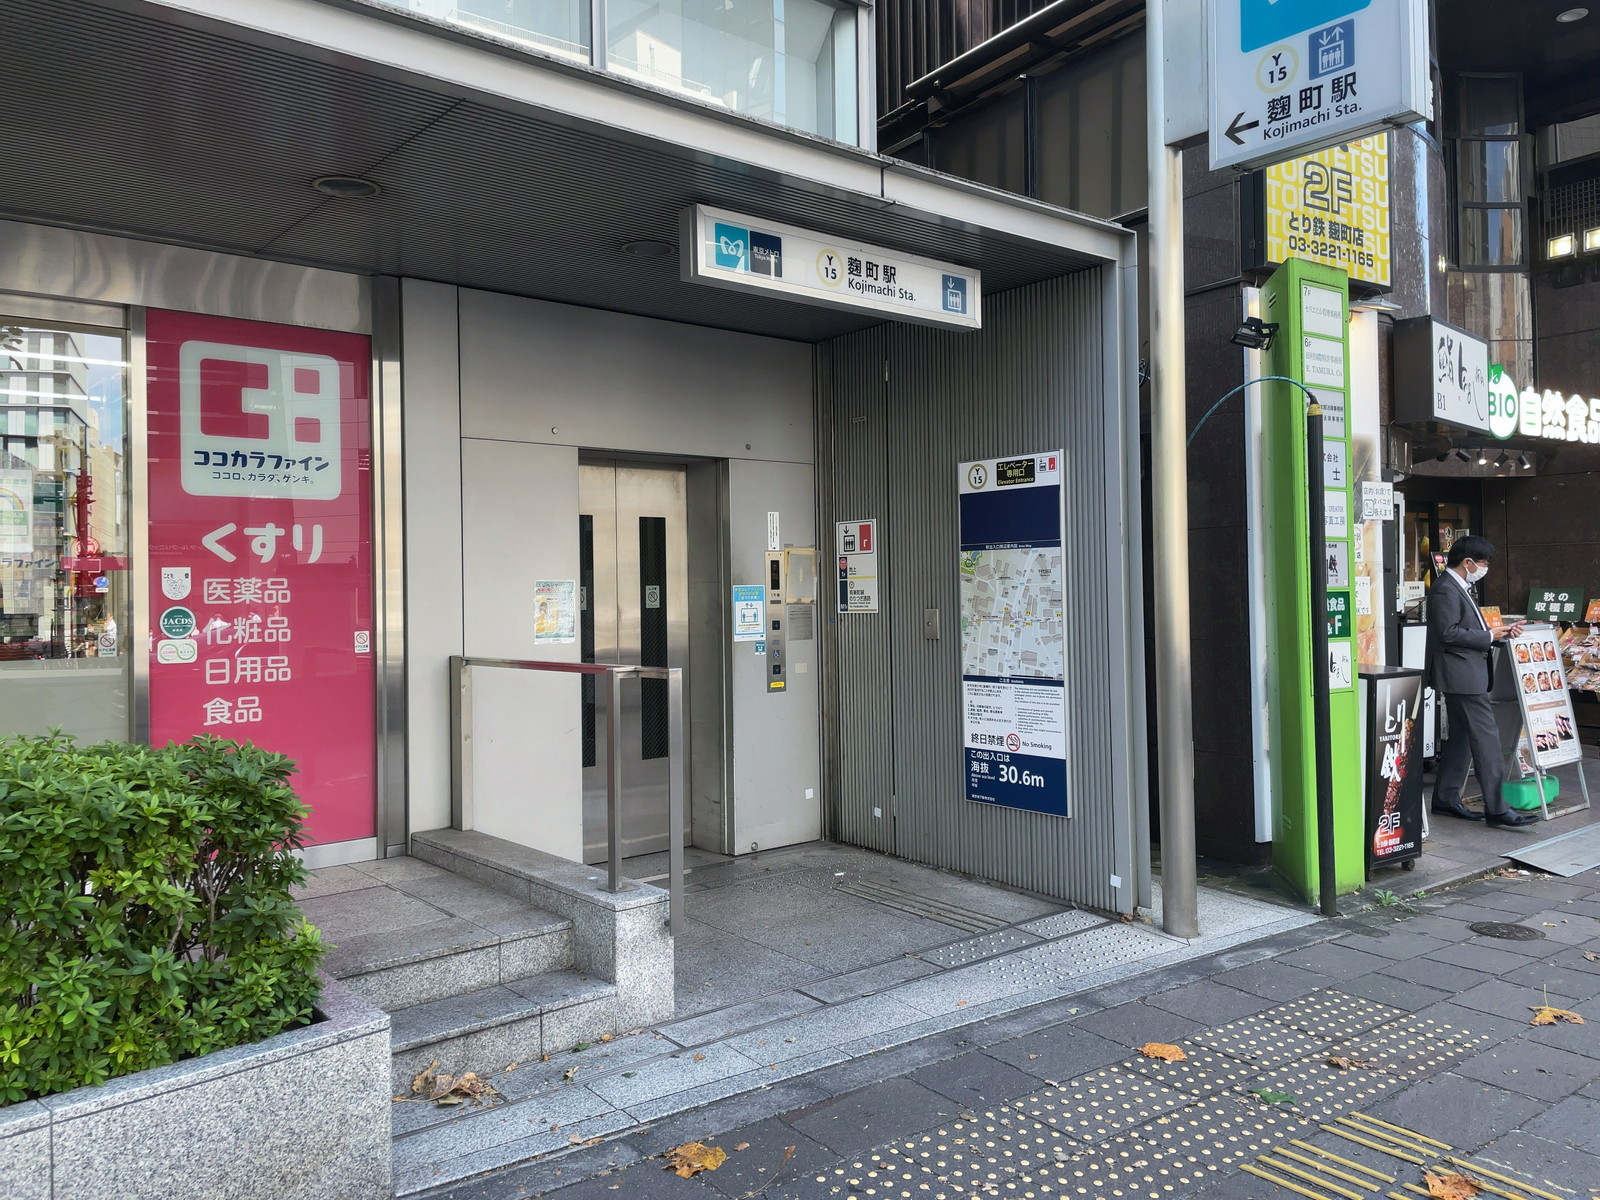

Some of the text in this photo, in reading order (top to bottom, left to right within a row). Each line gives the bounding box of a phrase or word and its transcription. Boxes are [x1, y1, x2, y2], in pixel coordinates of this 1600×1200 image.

[1272, 53, 1283, 67] Y
[1268, 66, 1288, 84] 15
[1263, 103, 1362, 140] Kojimachi Sta.
[1303, 160, 1353, 215] 2F
[1288, 211, 1326, 237] とり鉄
[1288, 234, 1374, 268] 03-3221-1165
[826, 255, 834, 266] Y
[824, 266, 837, 280] 15
[848, 278, 917, 302] Kojimachi Sta.
[1303, 286, 1311, 297] 7F
[1304, 337, 1312, 348] 6F
[1437, 392, 1447, 411] B1
[1489, 391, 1517, 419] BIO
[1519, 385, 1600, 444] 自然食品
[194, 450, 329, 472] ココカラファイン
[997, 461, 1034, 471] エレベーター
[1323, 453, 1339, 463] 会社
[212, 471, 315, 485] ココロ、カラダ、ゲンキ。
[973, 476, 983, 484] 15
[1006, 468, 1025, 478] 専用口
[1332, 467, 1341, 481] 士
[201, 522, 323, 563] くすり
[203, 577, 291, 604] 医薬品
[1543, 592, 1569, 602] 秋の
[1534, 602, 1575, 613] 収穫祭
[163, 617, 193, 625] JACDS
[203, 617, 291, 645] 化粧品
[205, 656, 291, 684] 日用品
[203, 696, 262, 726] 食品
[971, 733, 1004, 747] 終日禁煙
[1030, 742, 1052, 751] Smoking
[970, 750, 1010, 762] この出入口は
[970, 761, 989, 774] 海抜
[999, 764, 1044, 788] 30.6m
[1378, 812, 1401, 837] 2F
